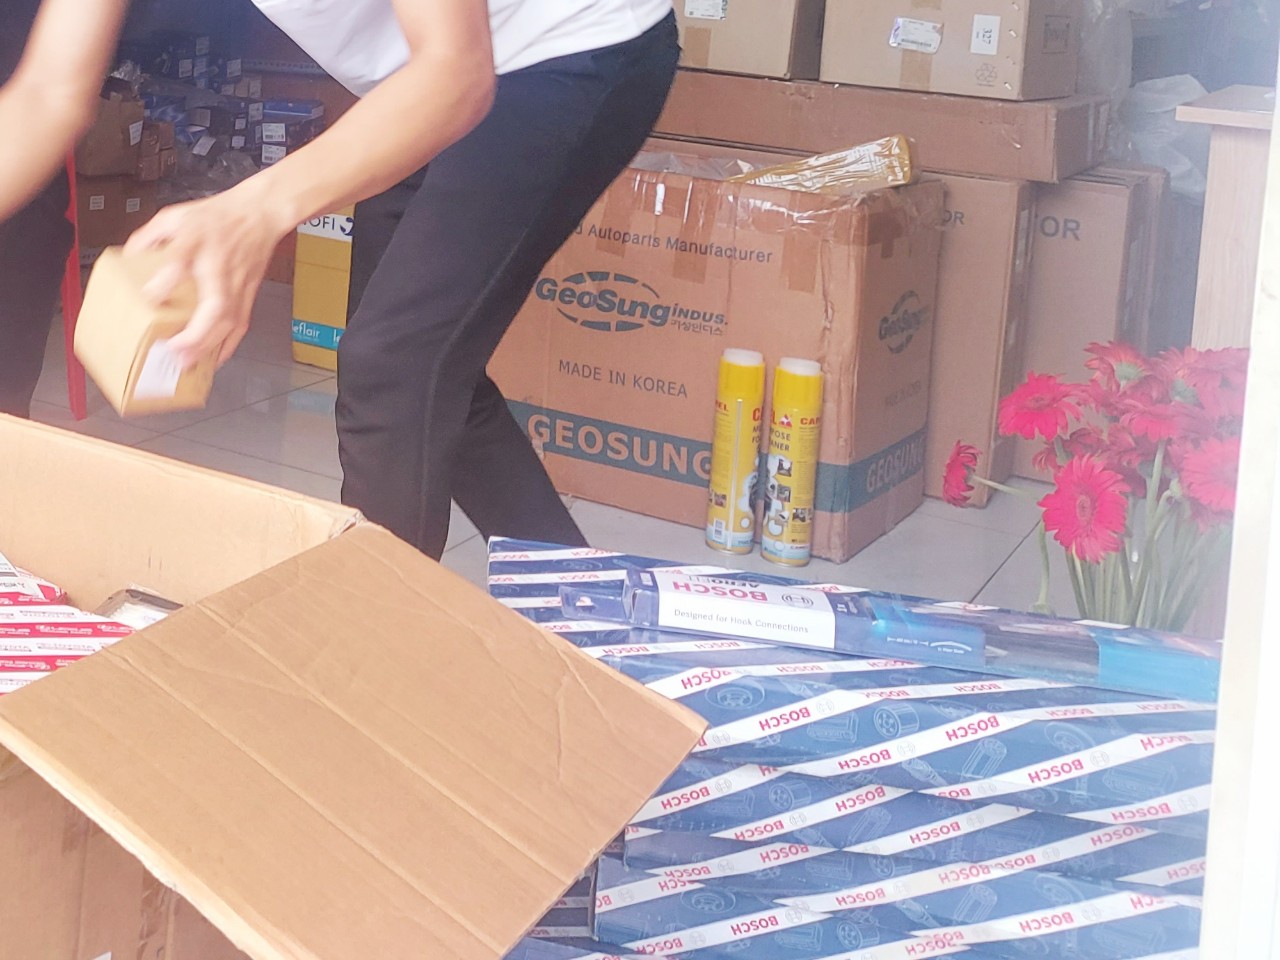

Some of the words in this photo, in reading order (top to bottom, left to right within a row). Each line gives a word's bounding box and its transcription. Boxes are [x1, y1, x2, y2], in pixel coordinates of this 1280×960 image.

[587, 224, 661, 249] Autoparts
[665, 237, 774, 264] Manufacturer
[535, 278, 670, 328] GeoSung
[558, 359, 603, 382] MADE
[608, 369, 626, 386] IN
[632, 377, 689, 398] KOREA
[527, 414, 712, 481] GEOSUNG
[672, 581, 769, 602] BOSCH
[673, 608, 714, 622] Designed
[716, 613, 728, 623] for
[730, 615, 753, 627] Hook
[755, 619, 810, 634] Connections
[758, 706, 812, 732] BOSCH
[944, 714, 1001, 742] BOSCH
[837, 749, 892, 771] BOSCH
[1027, 758, 1084, 784] BOSCH
[660, 785, 711, 811] BOSCH
[834, 785, 887, 813] BOSCH
[1112, 801, 1172, 822] BOSCH
[734, 819, 785, 841] BOSCH
[909, 821, 961, 844] BOSCH
[759, 843, 810, 864] BOSCH
[937, 863, 993, 885] BOSCH
[835, 887, 886, 907] BOSCH
[730, 915, 779, 936] BOSCH
[1019, 910, 1075, 934] BOSCH
